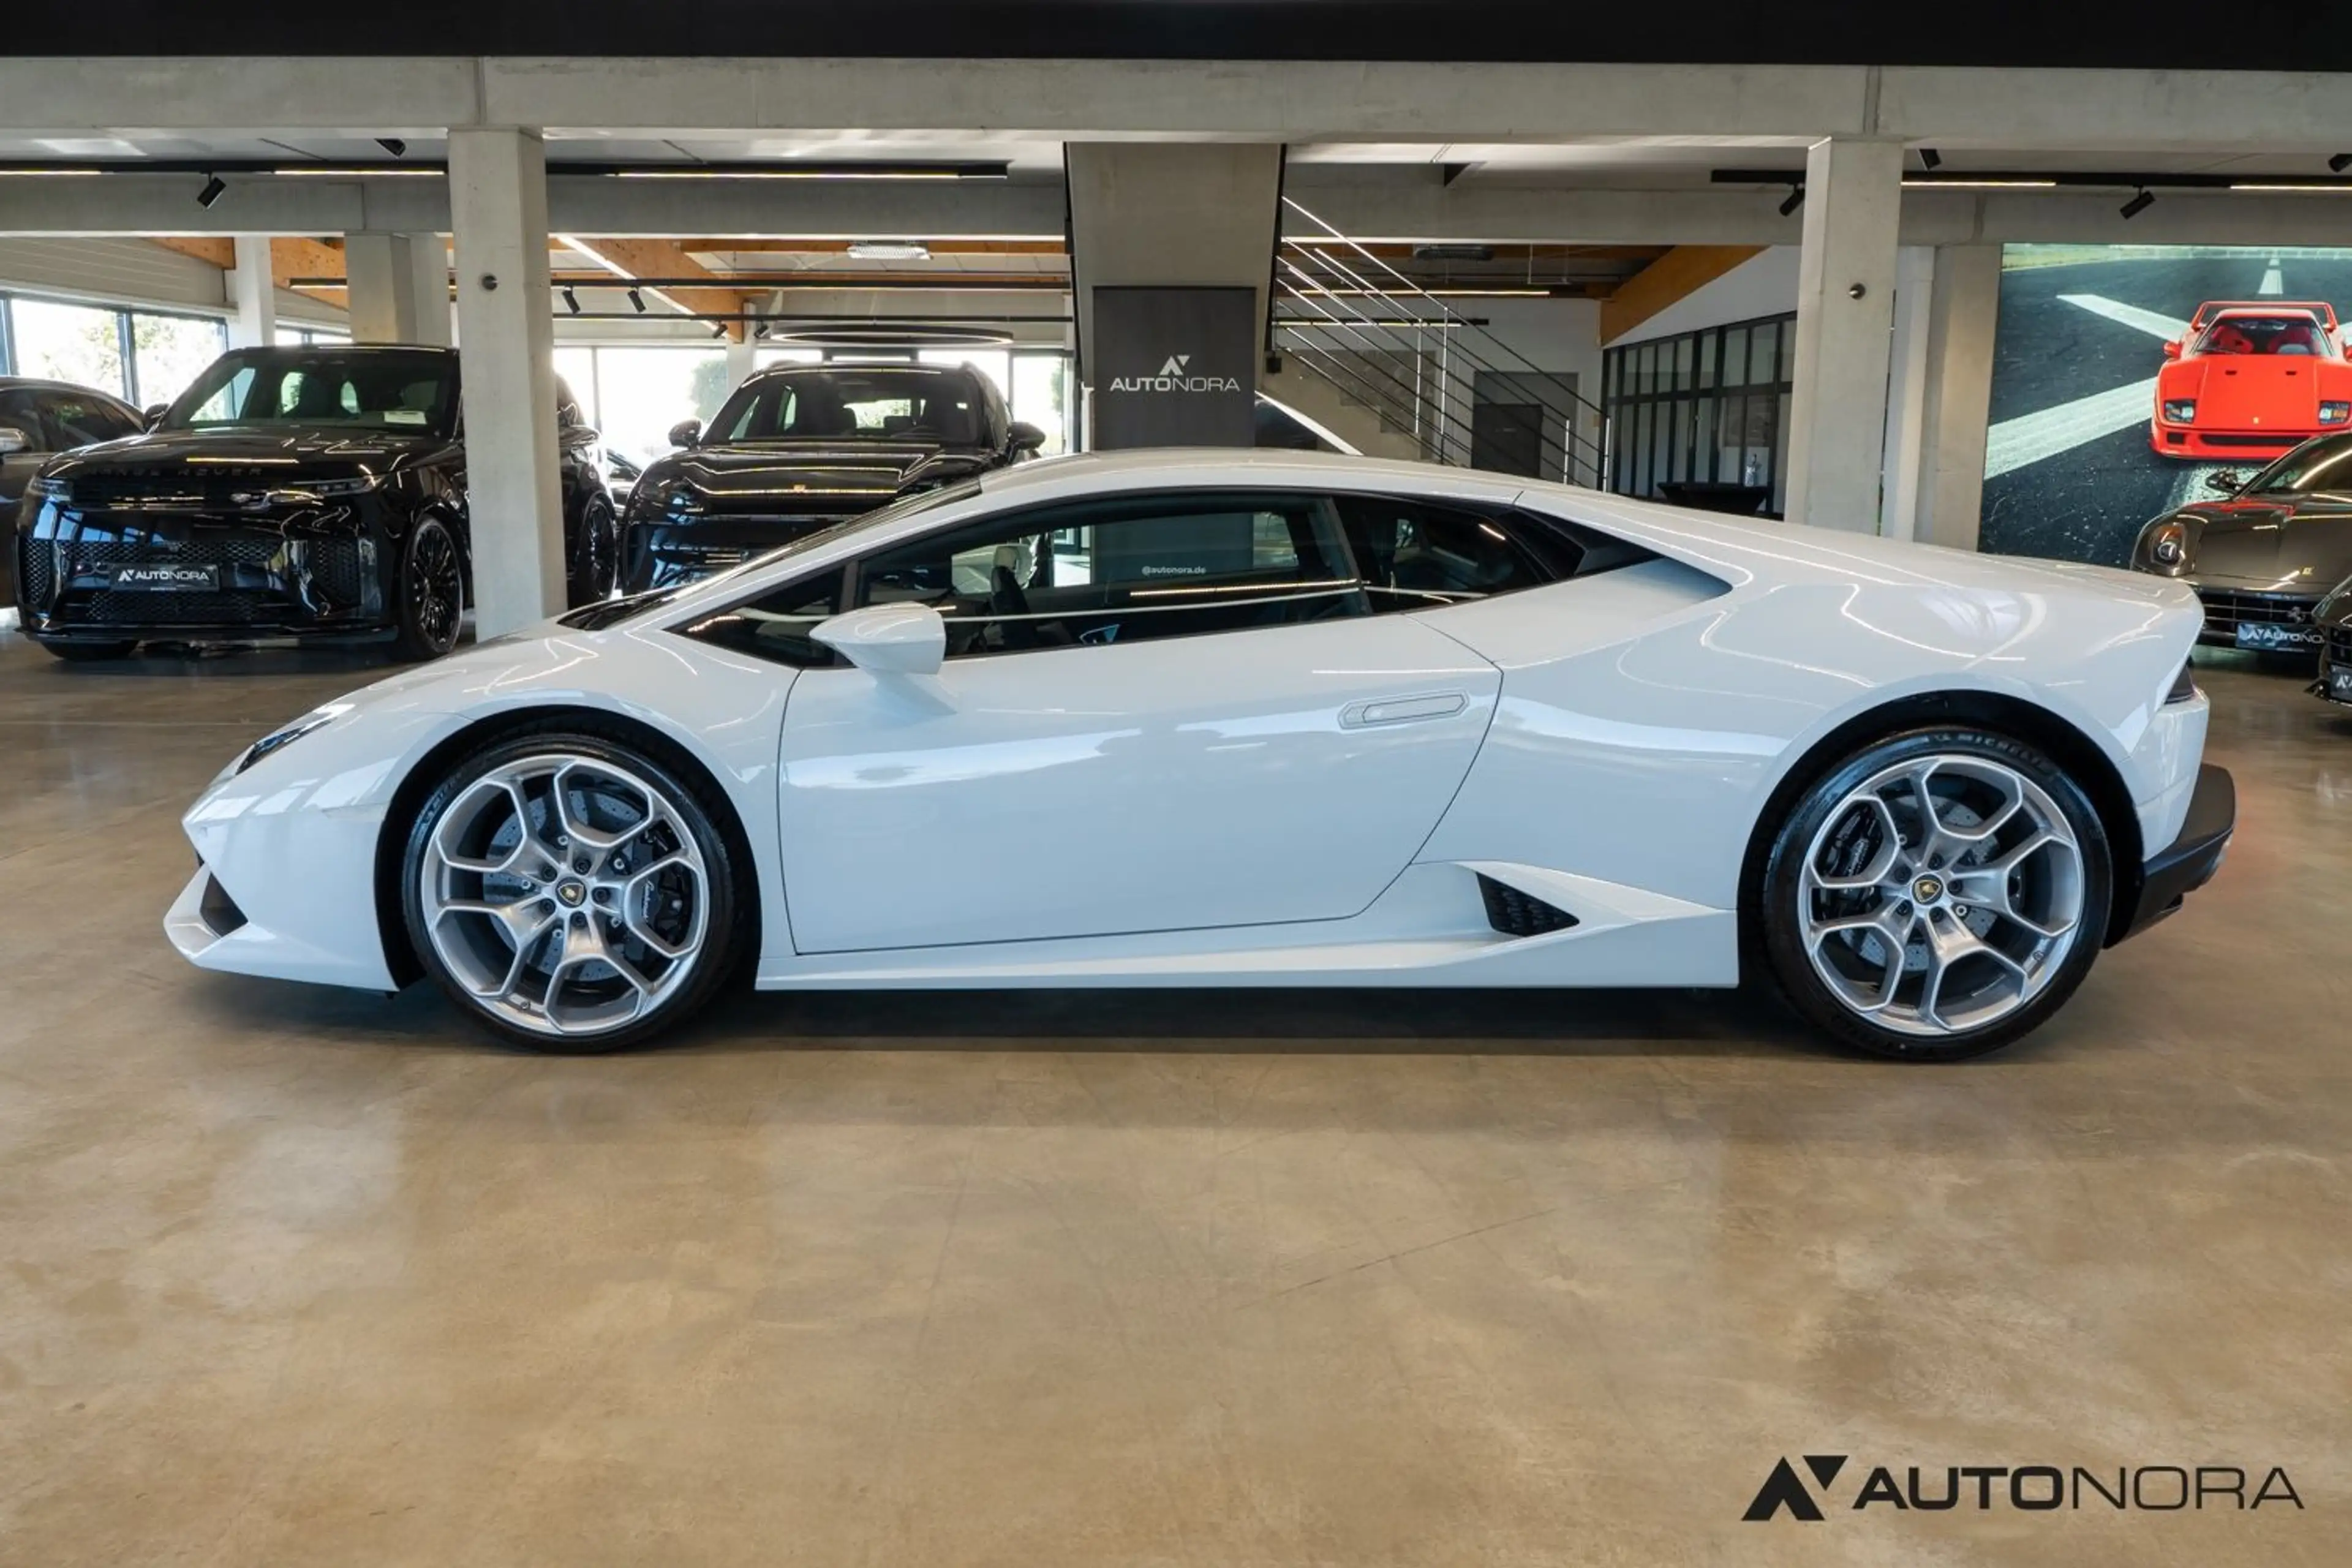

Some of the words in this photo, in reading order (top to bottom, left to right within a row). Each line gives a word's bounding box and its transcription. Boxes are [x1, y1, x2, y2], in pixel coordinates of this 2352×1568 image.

[1110, 377, 1241, 391] AUTONORA
[135, 571, 209, 581] AUTONORA
[1142, 565, 1207, 576] @autonora.de
[2263, 629, 2325, 643] AUTONO
